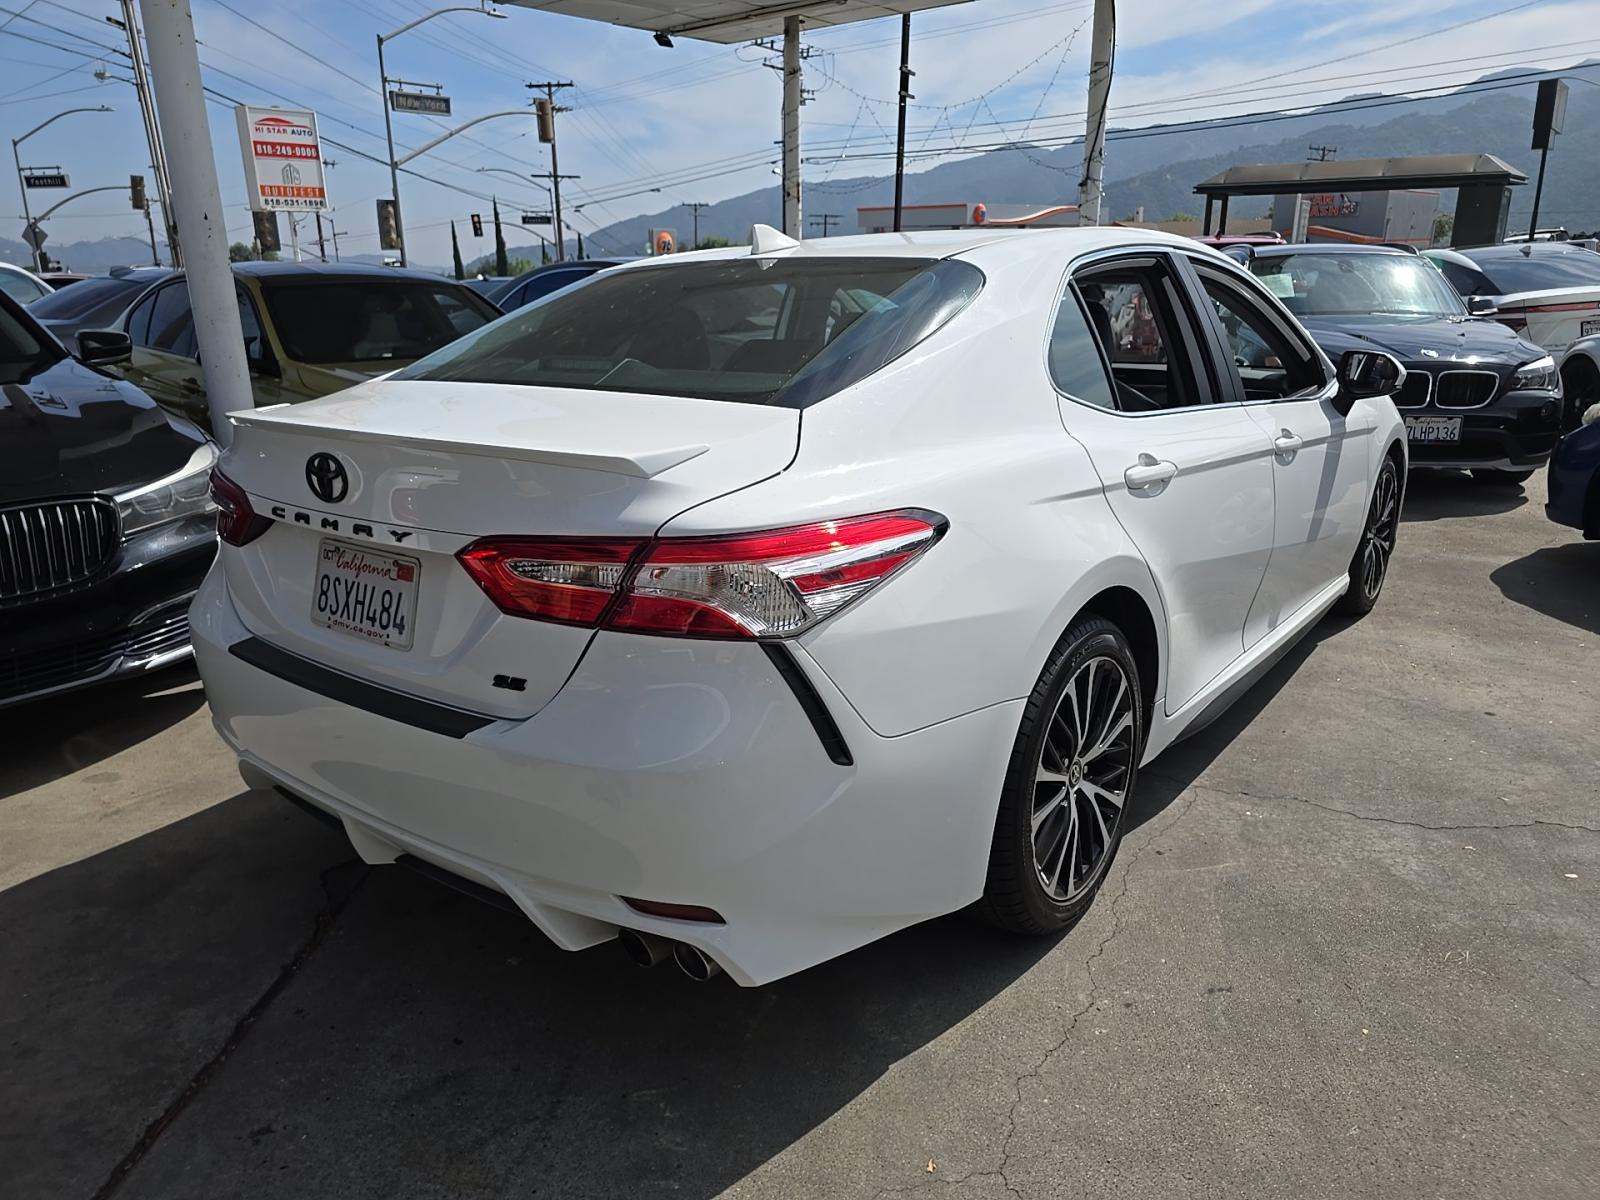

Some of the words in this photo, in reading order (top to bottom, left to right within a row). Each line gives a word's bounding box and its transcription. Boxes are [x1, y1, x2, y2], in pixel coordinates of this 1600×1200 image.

[424, 98, 447, 111] York
[267, 128, 288, 136] STAR
[1309, 206, 1341, 216] ASH
[1406, 425, 1457, 440] 7LHP136
[271, 506, 413, 542] CAMRY
[335, 546, 398, 581] California
[318, 574, 406, 635] 8SXH484
